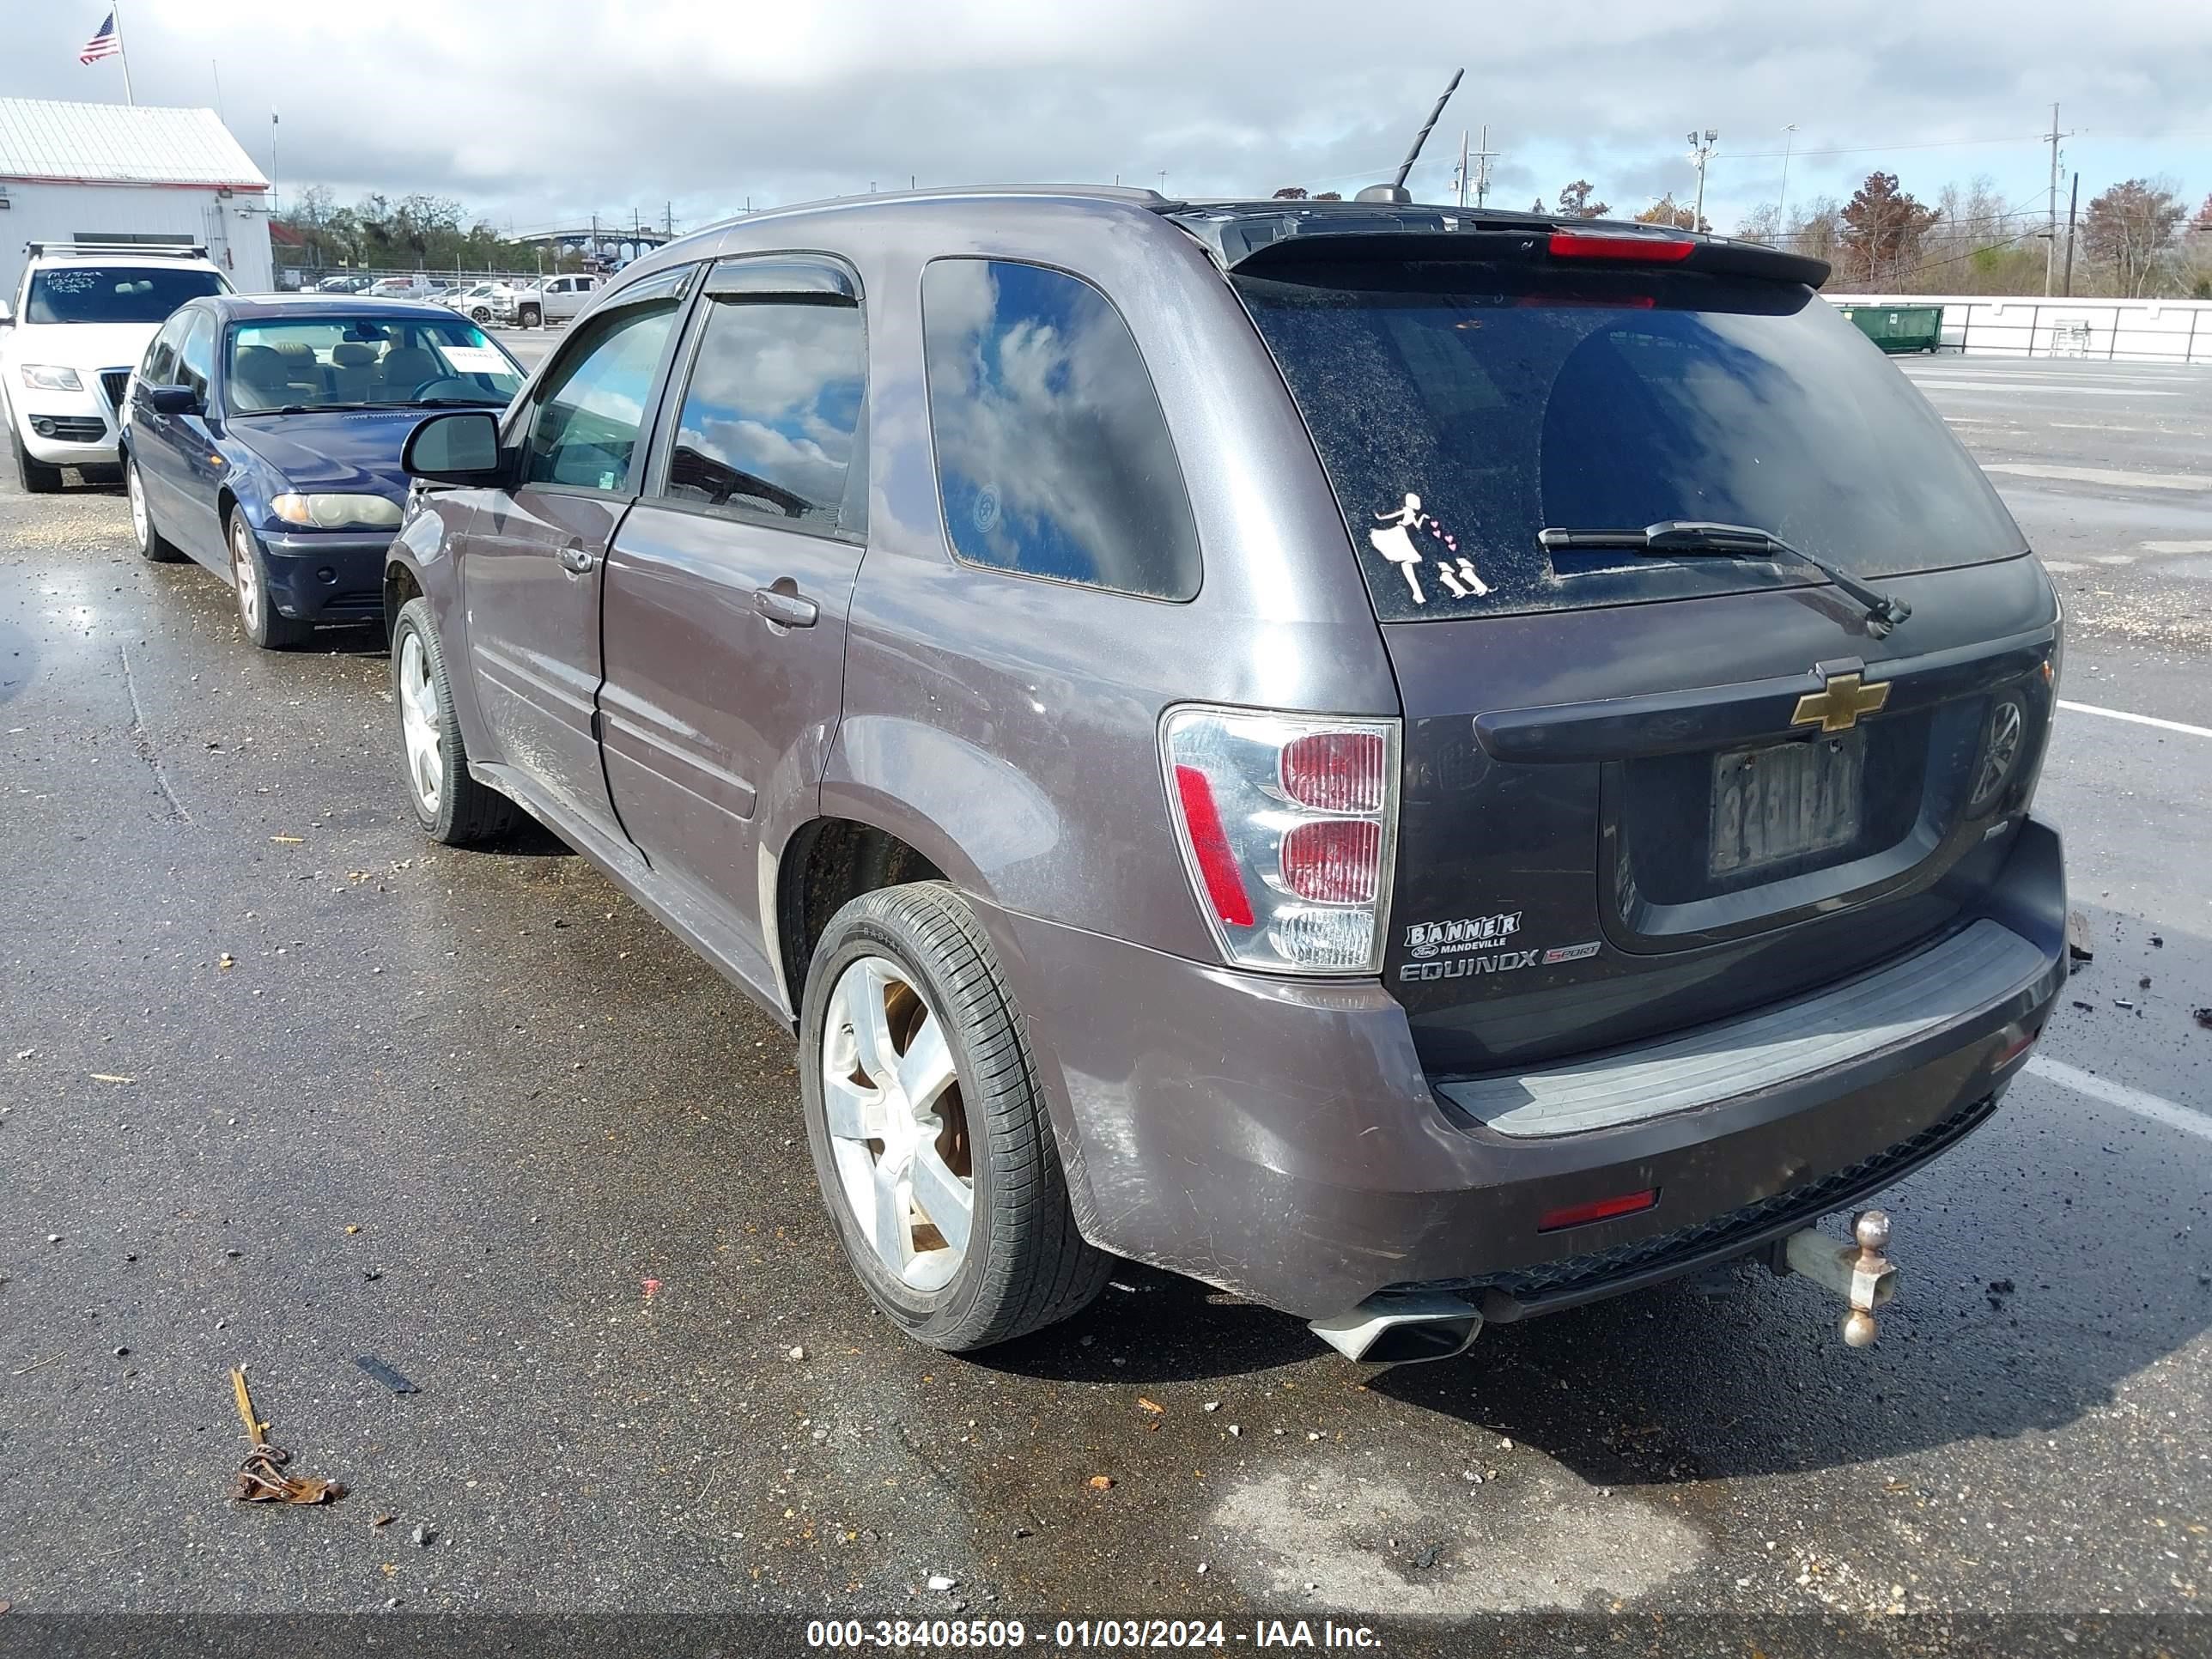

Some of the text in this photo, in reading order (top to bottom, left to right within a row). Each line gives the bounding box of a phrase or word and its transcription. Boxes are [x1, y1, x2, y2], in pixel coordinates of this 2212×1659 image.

[1409, 915, 1516, 945] BANNER
[1413, 937, 1507, 957] Ford MANDEVILLE
[1400, 949, 1540, 981] EQUINOX
